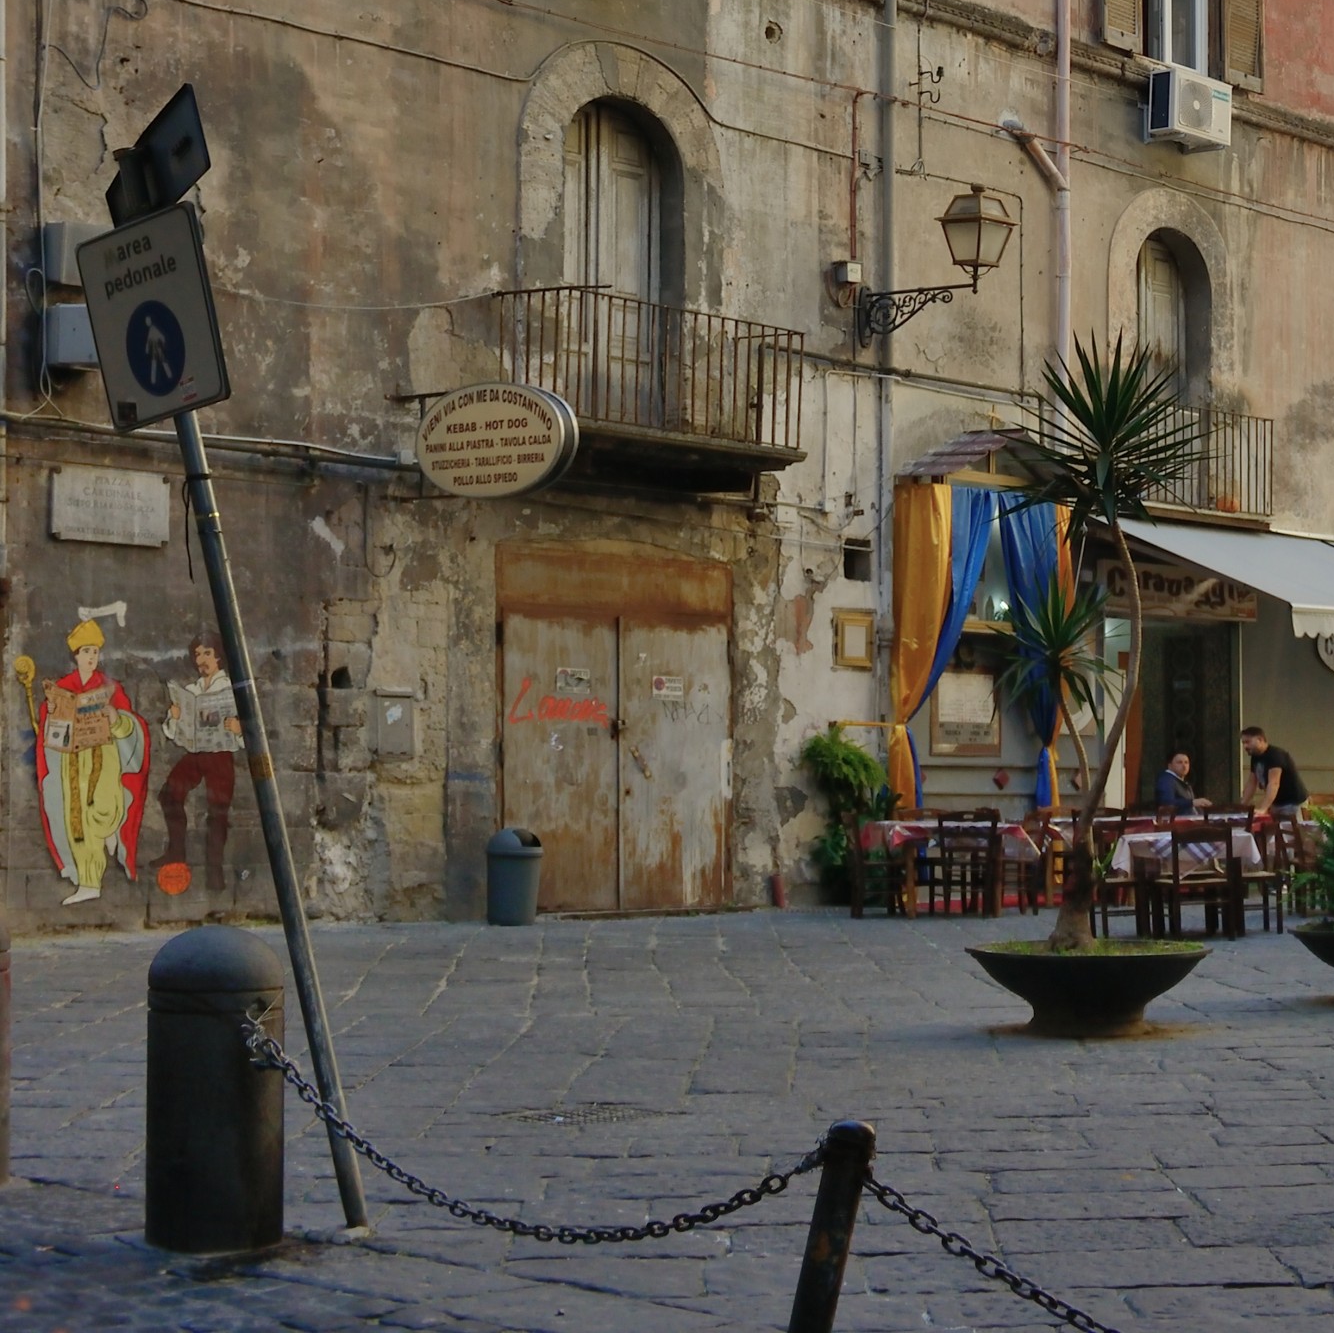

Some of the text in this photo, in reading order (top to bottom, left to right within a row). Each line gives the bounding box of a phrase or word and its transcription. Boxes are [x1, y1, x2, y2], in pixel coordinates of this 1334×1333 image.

[116, 235, 152, 261] area
[104, 253, 177, 300] pedonale
[422, 388, 553, 442] VIENI VIA CON ME DA COSTANTINO
[446, 417, 528, 435] KEBAB HOT DOG
[425, 434, 552, 454] PANINI ALLA PIASTRA TAVOLA CALDA
[474, 454, 513, 468] TARALLIFICIO
[517, 452, 545, 465] BIRRERIA
[453, 471, 518, 486] POLLO ALLO SPIEDO
